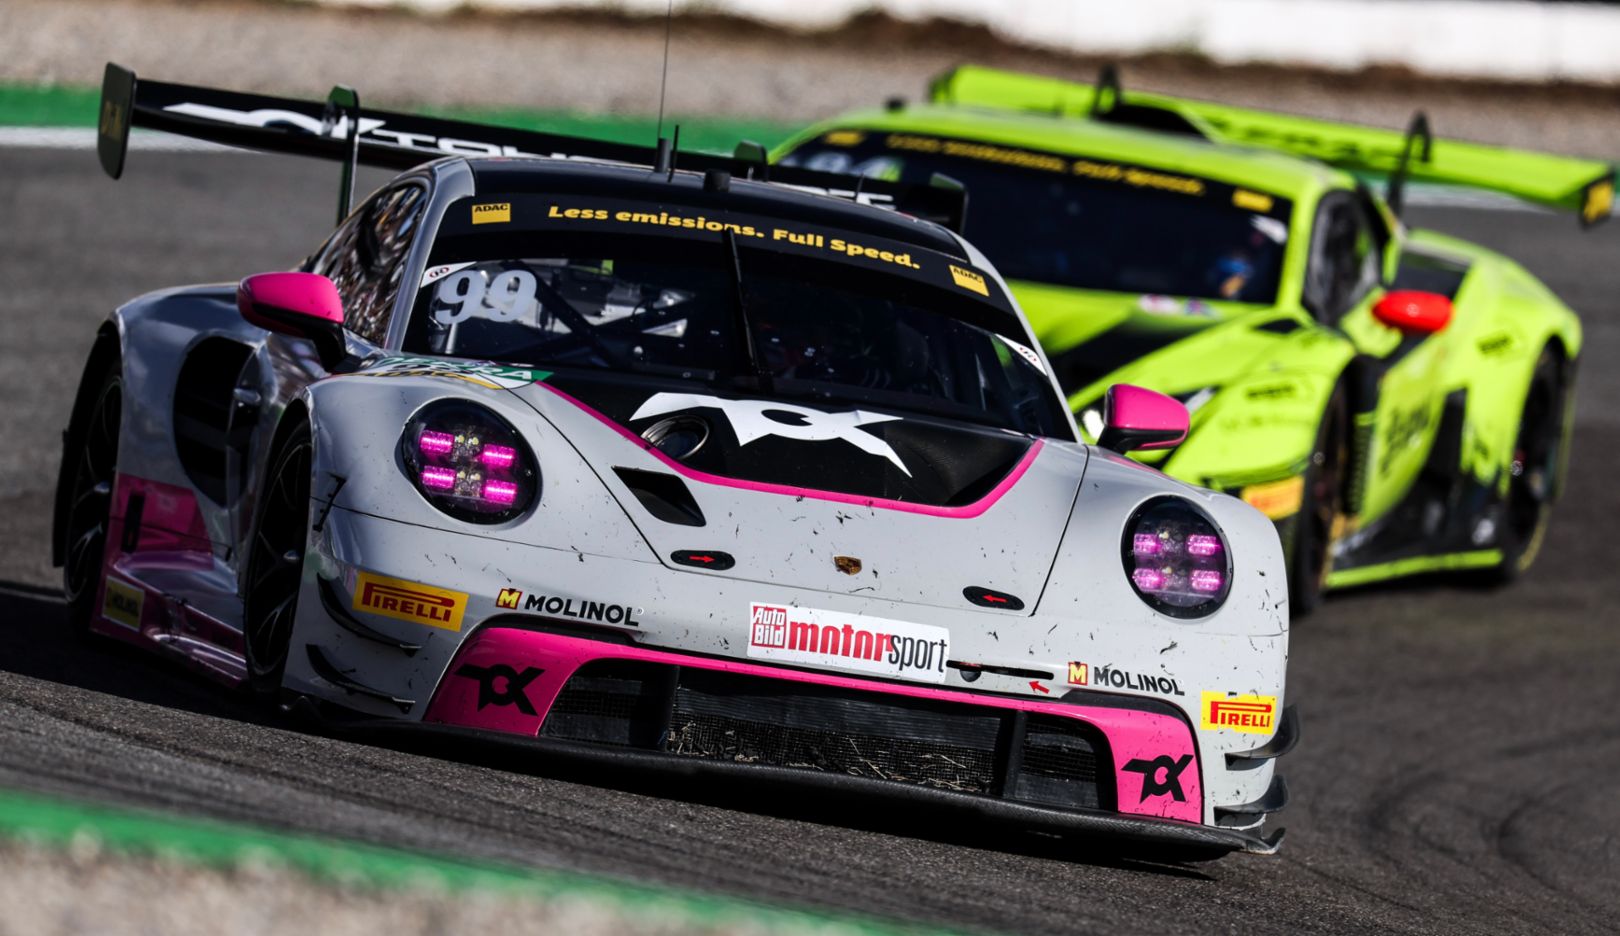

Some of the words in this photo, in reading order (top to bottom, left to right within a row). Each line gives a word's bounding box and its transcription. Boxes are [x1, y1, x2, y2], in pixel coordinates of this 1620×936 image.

[474, 204, 509, 213] ADAC
[548, 205, 608, 221] Less
[615, 210, 765, 239] emissions.
[773, 228, 824, 248] Full
[830, 239, 921, 270] Speed.
[953, 267, 982, 284] ADAC
[434, 269, 537, 325] 99
[361, 580, 456, 623] PIRELLI
[524, 594, 639, 627] MOLINOL
[753, 607, 786, 626] Auto
[754, 625, 786, 646] Bild
[1093, 665, 1185, 697] MOLINOL
[1209, 699, 1272, 731] PIRELLI
